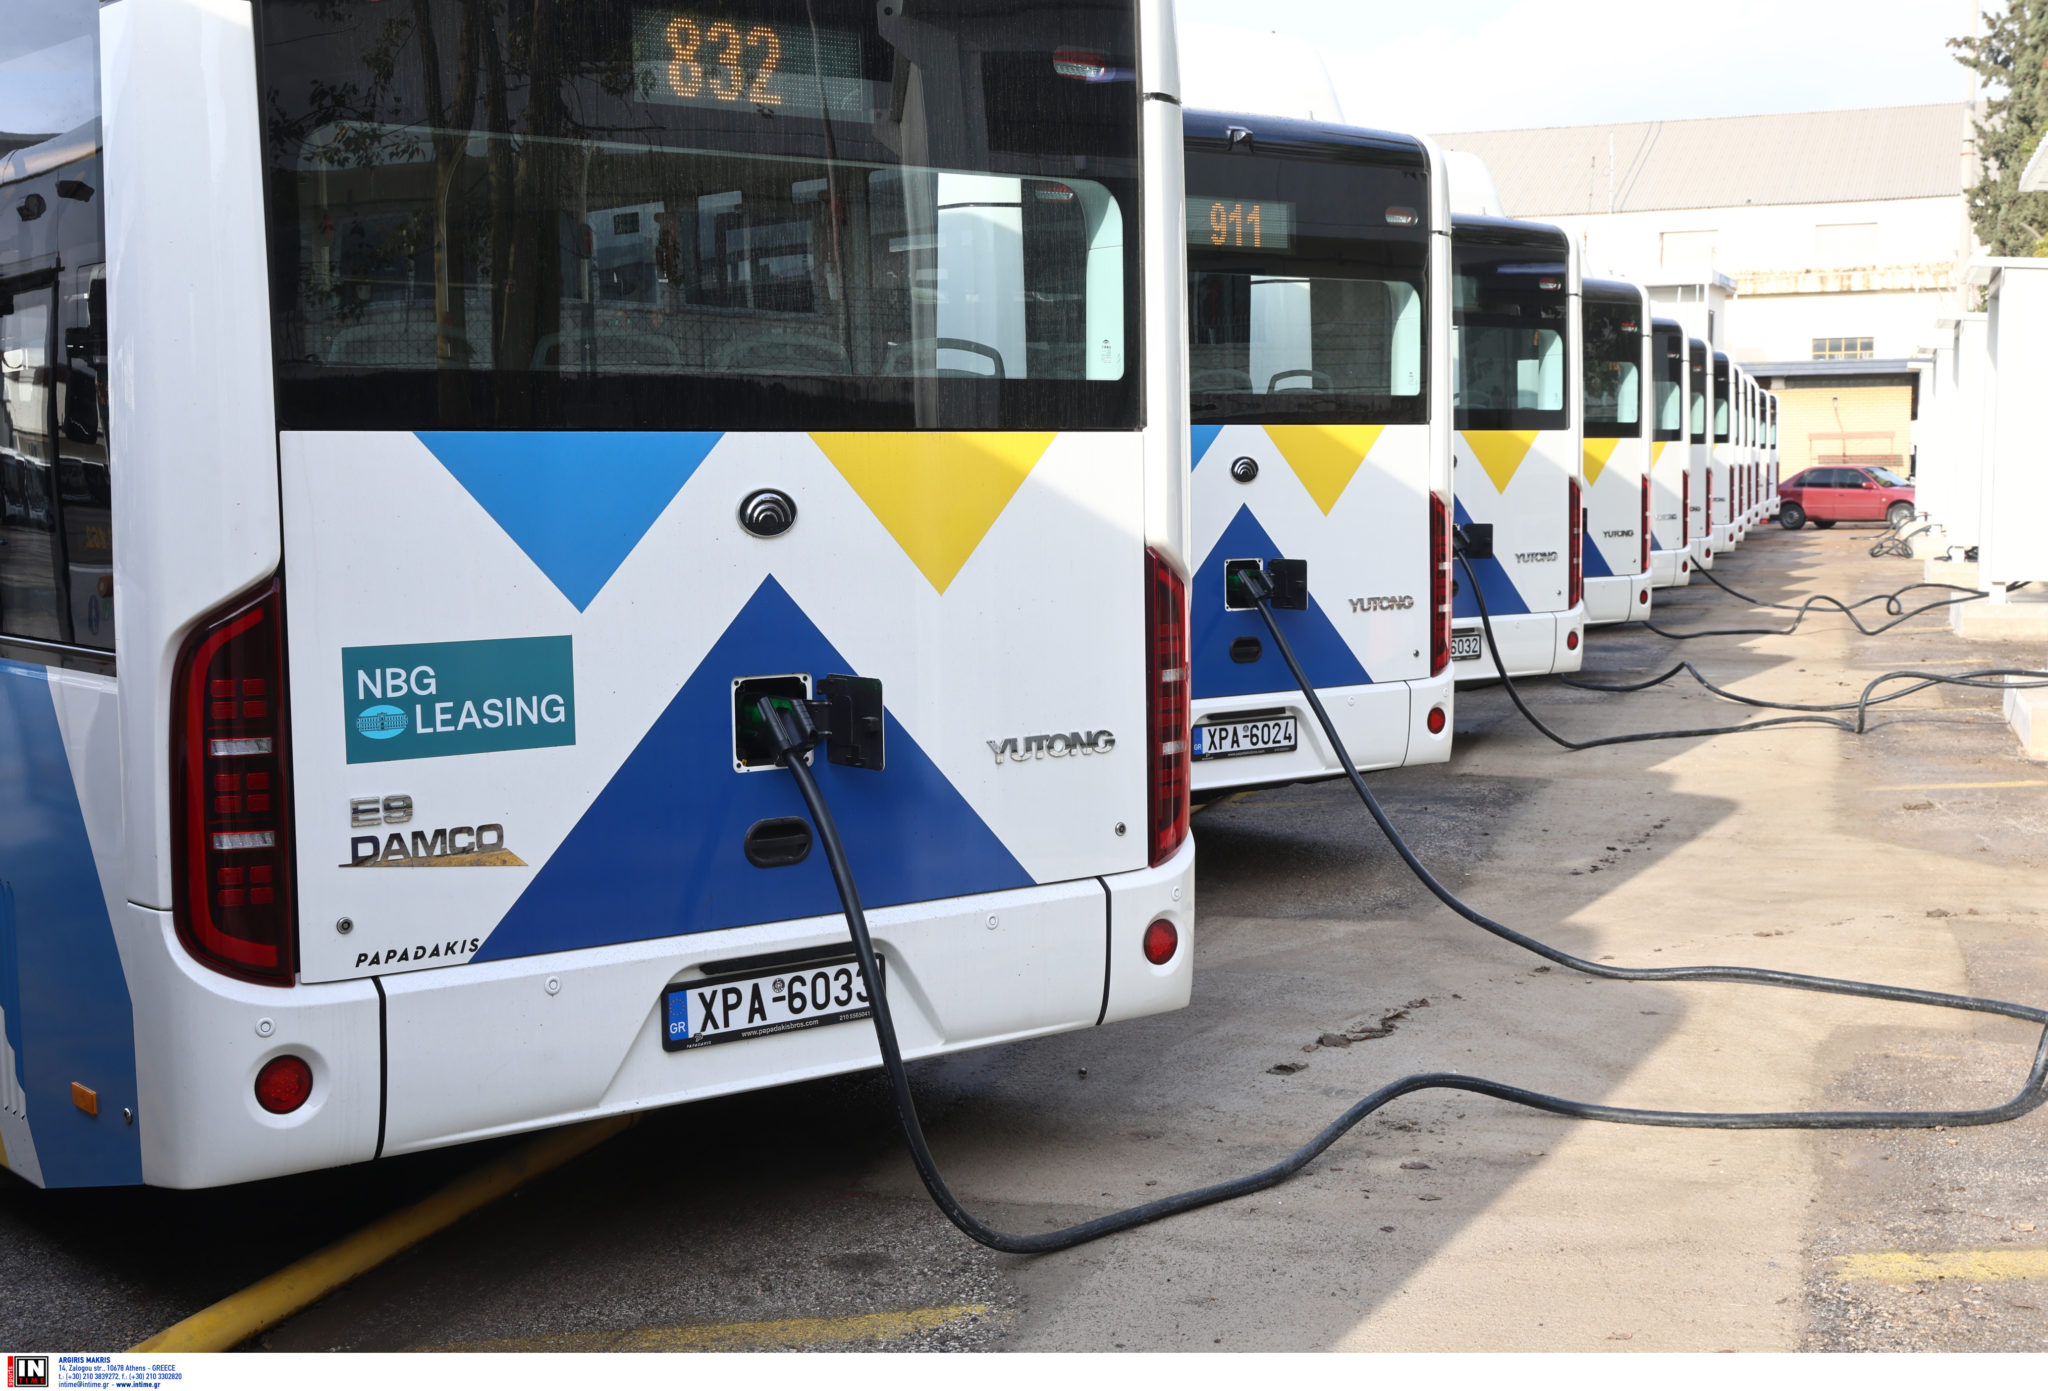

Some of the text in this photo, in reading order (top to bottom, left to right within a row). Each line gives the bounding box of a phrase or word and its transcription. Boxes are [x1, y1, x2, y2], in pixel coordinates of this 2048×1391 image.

[666, 17, 782, 104] 832
[1210, 202, 1261, 248] 911
[1514, 551, 1559, 564] YUTONG
[1348, 594, 1415, 614] YUTONG
[357, 665, 437, 700] NBG
[415, 694, 566, 734] LEASING
[986, 729, 1116, 766] YUTONG
[1193, 743, 1202, 751] GR
[1207, 721, 1293, 751] XPA-6024
[350, 794, 413, 828] E9
[350, 823, 504, 866] DAMCO
[355, 937, 480, 968] PAPADAKIS
[669, 1021, 686, 1034] GR
[741, 1018, 819, 1038] www.papadakisbros.com
